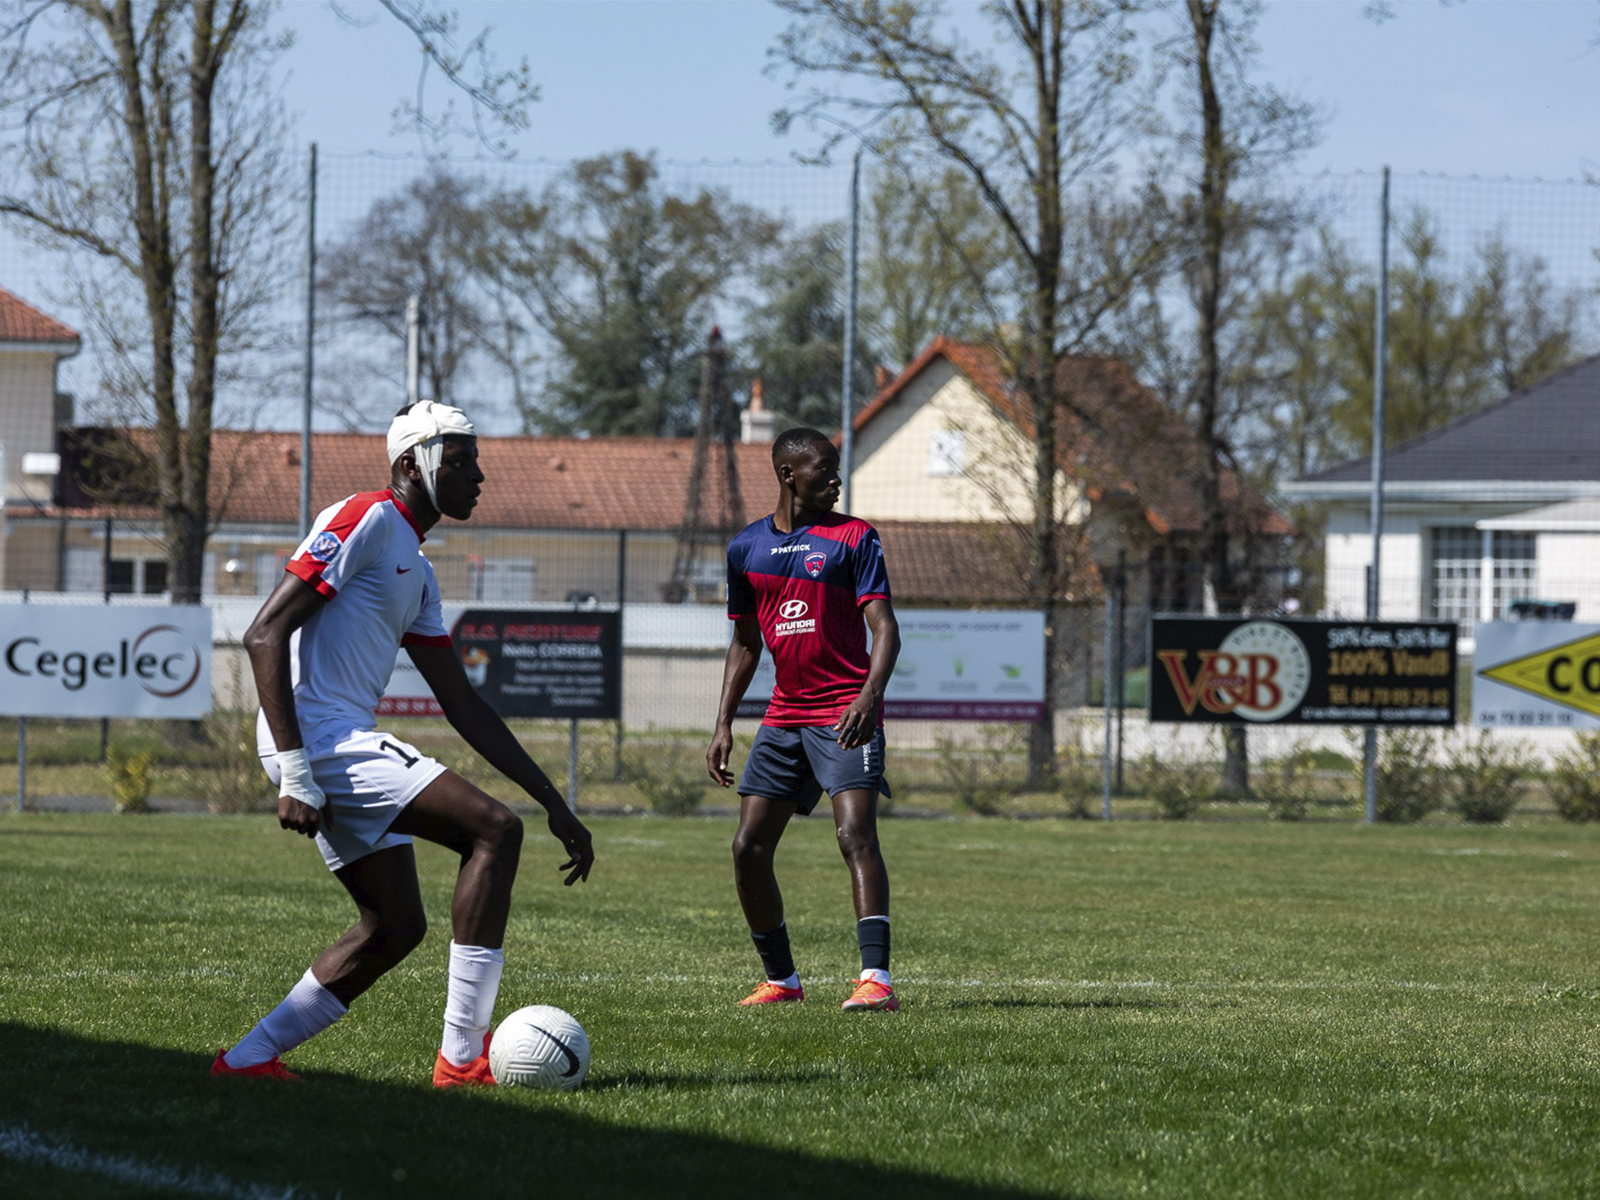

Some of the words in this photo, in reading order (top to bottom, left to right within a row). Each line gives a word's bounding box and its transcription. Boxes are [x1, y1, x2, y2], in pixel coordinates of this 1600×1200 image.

[778, 544, 811, 554] PATRICK
[775, 618, 816, 631] HYUNDAI
[5, 636, 187, 691] Cegelec
[538, 642, 603, 659] CORREIA
[1327, 648, 1389, 676] 100%
[1156, 649, 1283, 717] V&B
[379, 739, 420, 769] 1
